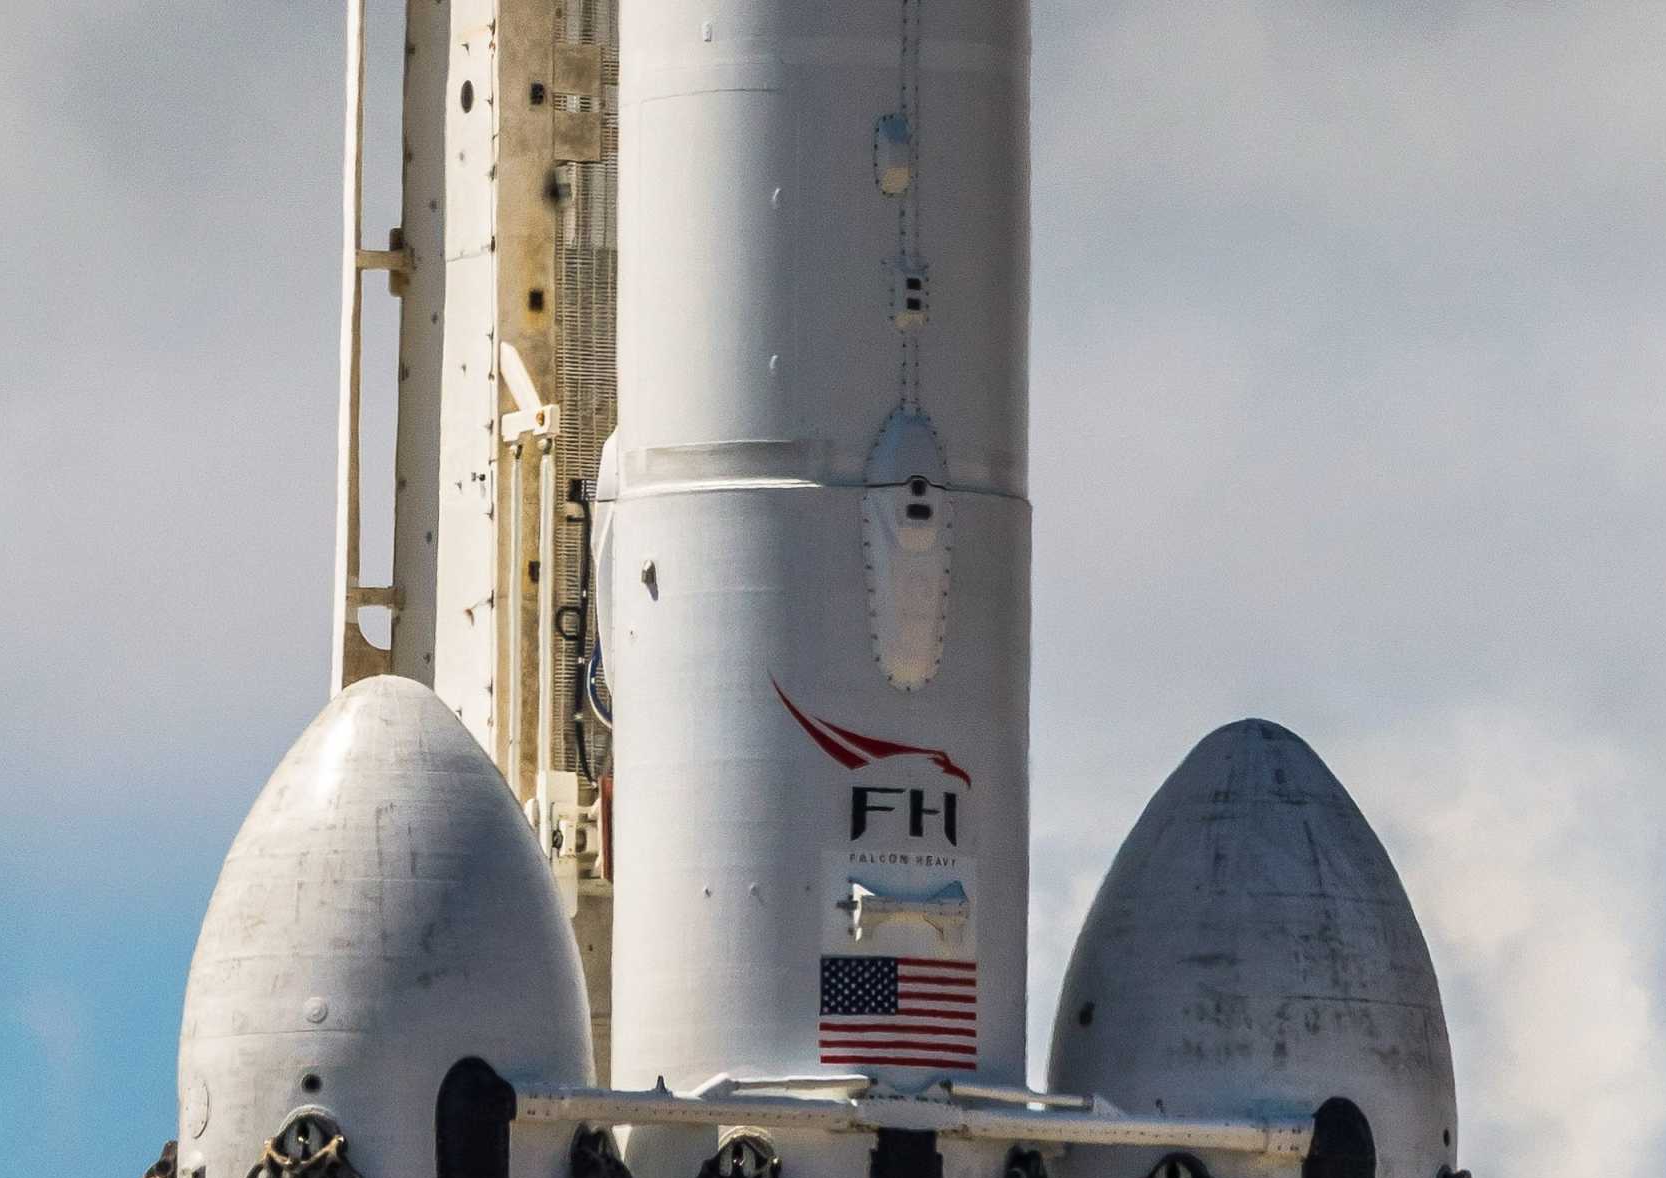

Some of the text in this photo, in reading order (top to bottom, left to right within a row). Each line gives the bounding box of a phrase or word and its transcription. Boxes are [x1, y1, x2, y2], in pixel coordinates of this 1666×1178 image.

[850, 786, 957, 847] FH
[849, 854, 957, 867] FALCON HEAVY
